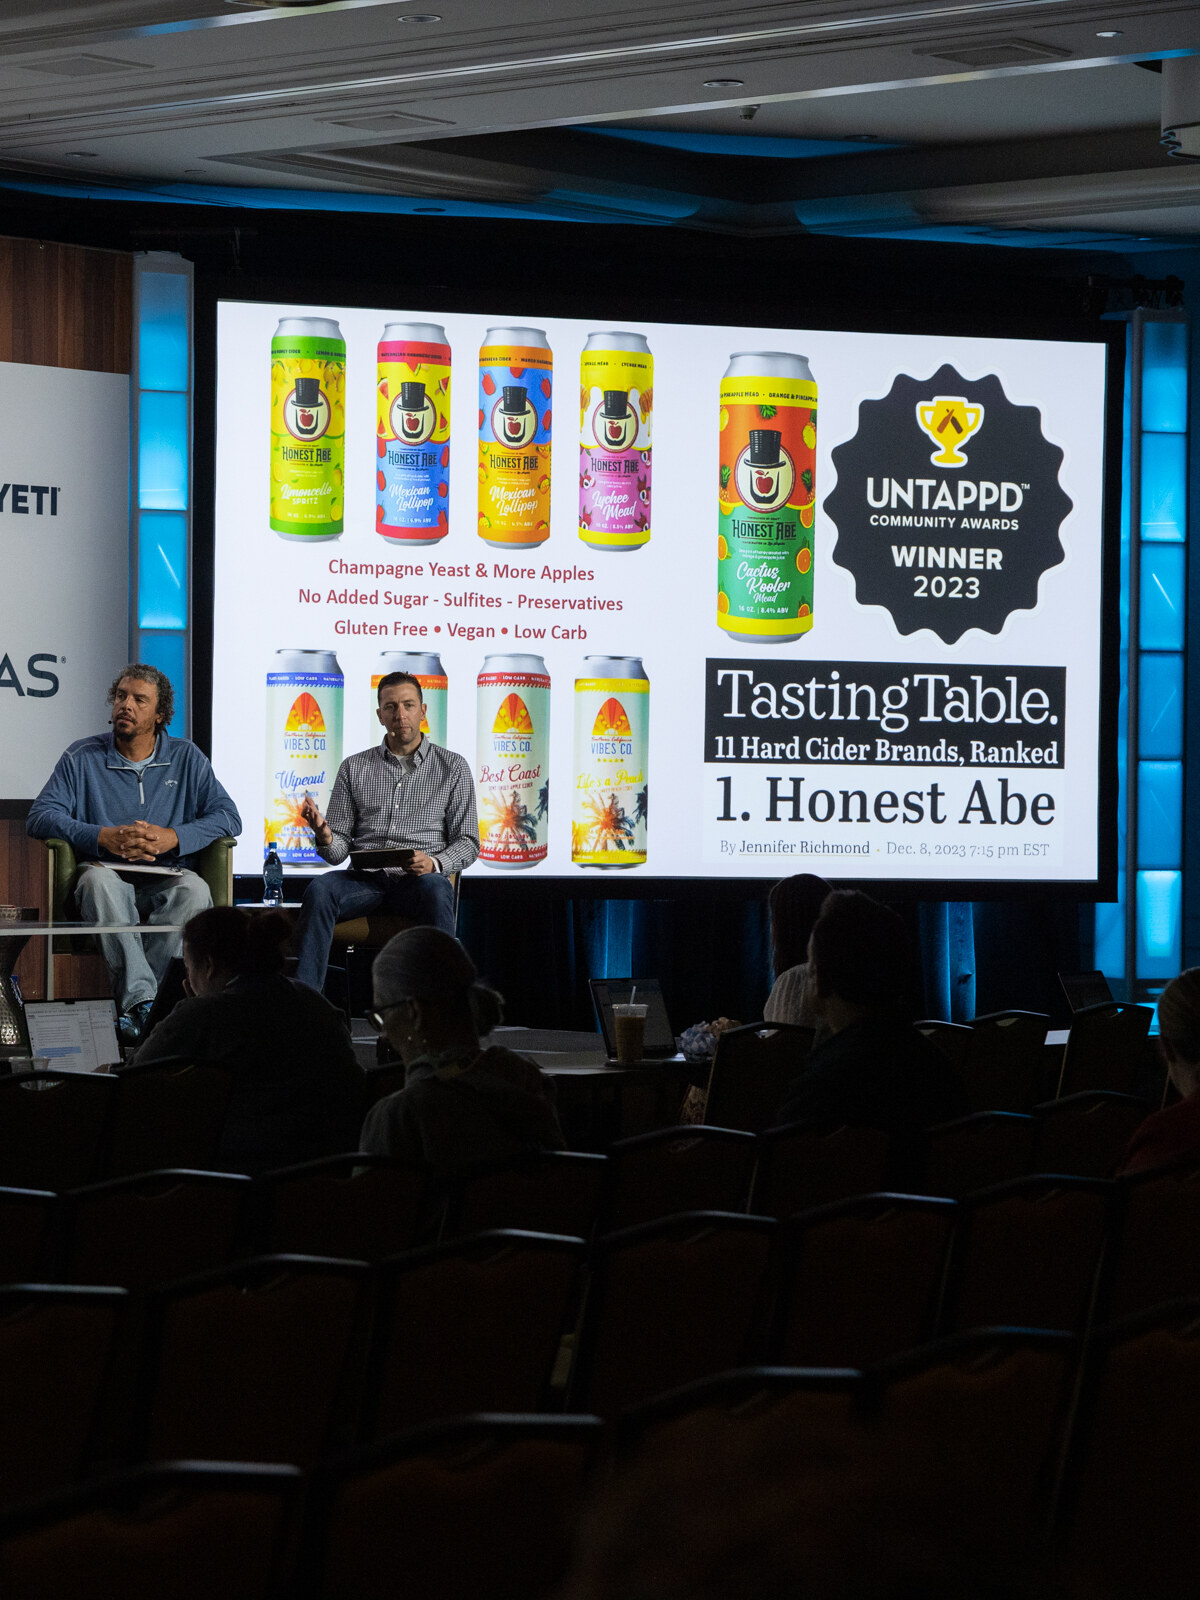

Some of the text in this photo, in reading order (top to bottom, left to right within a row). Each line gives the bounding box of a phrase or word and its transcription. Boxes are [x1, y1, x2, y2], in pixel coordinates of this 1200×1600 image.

[282, 446, 332, 463] HONEST ABE
[388, 450, 438, 467] HONEST ABE
[490, 454, 538, 470] HONEST ABE
[591, 457, 639, 473] HONEST ABE
[280, 483, 332, 499] Limoncello
[389, 483, 430, 498] Mexican
[489, 486, 535, 501] Mexican
[592, 490, 629, 508] Lychee
[292, 497, 318, 505] SPRITZ
[396, 496, 434, 512] Lollipop
[496, 500, 538, 517] Lollipop
[602, 500, 637, 522] Mead
[732, 519, 796, 540] HONEST ABE
[869, 514, 1020, 531] COMMUNITY AWARDS
[891, 545, 1003, 570] WINNER
[328, 558, 594, 584] Champagne Yeast & More Apples
[736, 561, 780, 580] Cactus
[746, 577, 791, 594] Kooler
[914, 576, 980, 598] 2023
[298, 589, 623, 611] No Added Sugar Sulfites Preservatives
[753, 593, 778, 603] Mead
[334, 620, 587, 641] Gluten Free Vegan Low Carb
[284, 738, 310, 750] VIBES
[493, 741, 516, 751] VIBES
[591, 743, 617, 754] VIBES
[715, 736, 1058, 767] 11 Hard Cider Brands, Ranked
[275, 770, 325, 791] Wipeout
[480, 764, 541, 783] Best Coast
[716, 776, 1056, 826] 1. Honest Abe
[720, 840, 1050, 859] By Jennifer Richmond Dec. 8, 2023 7:15 pm EST
